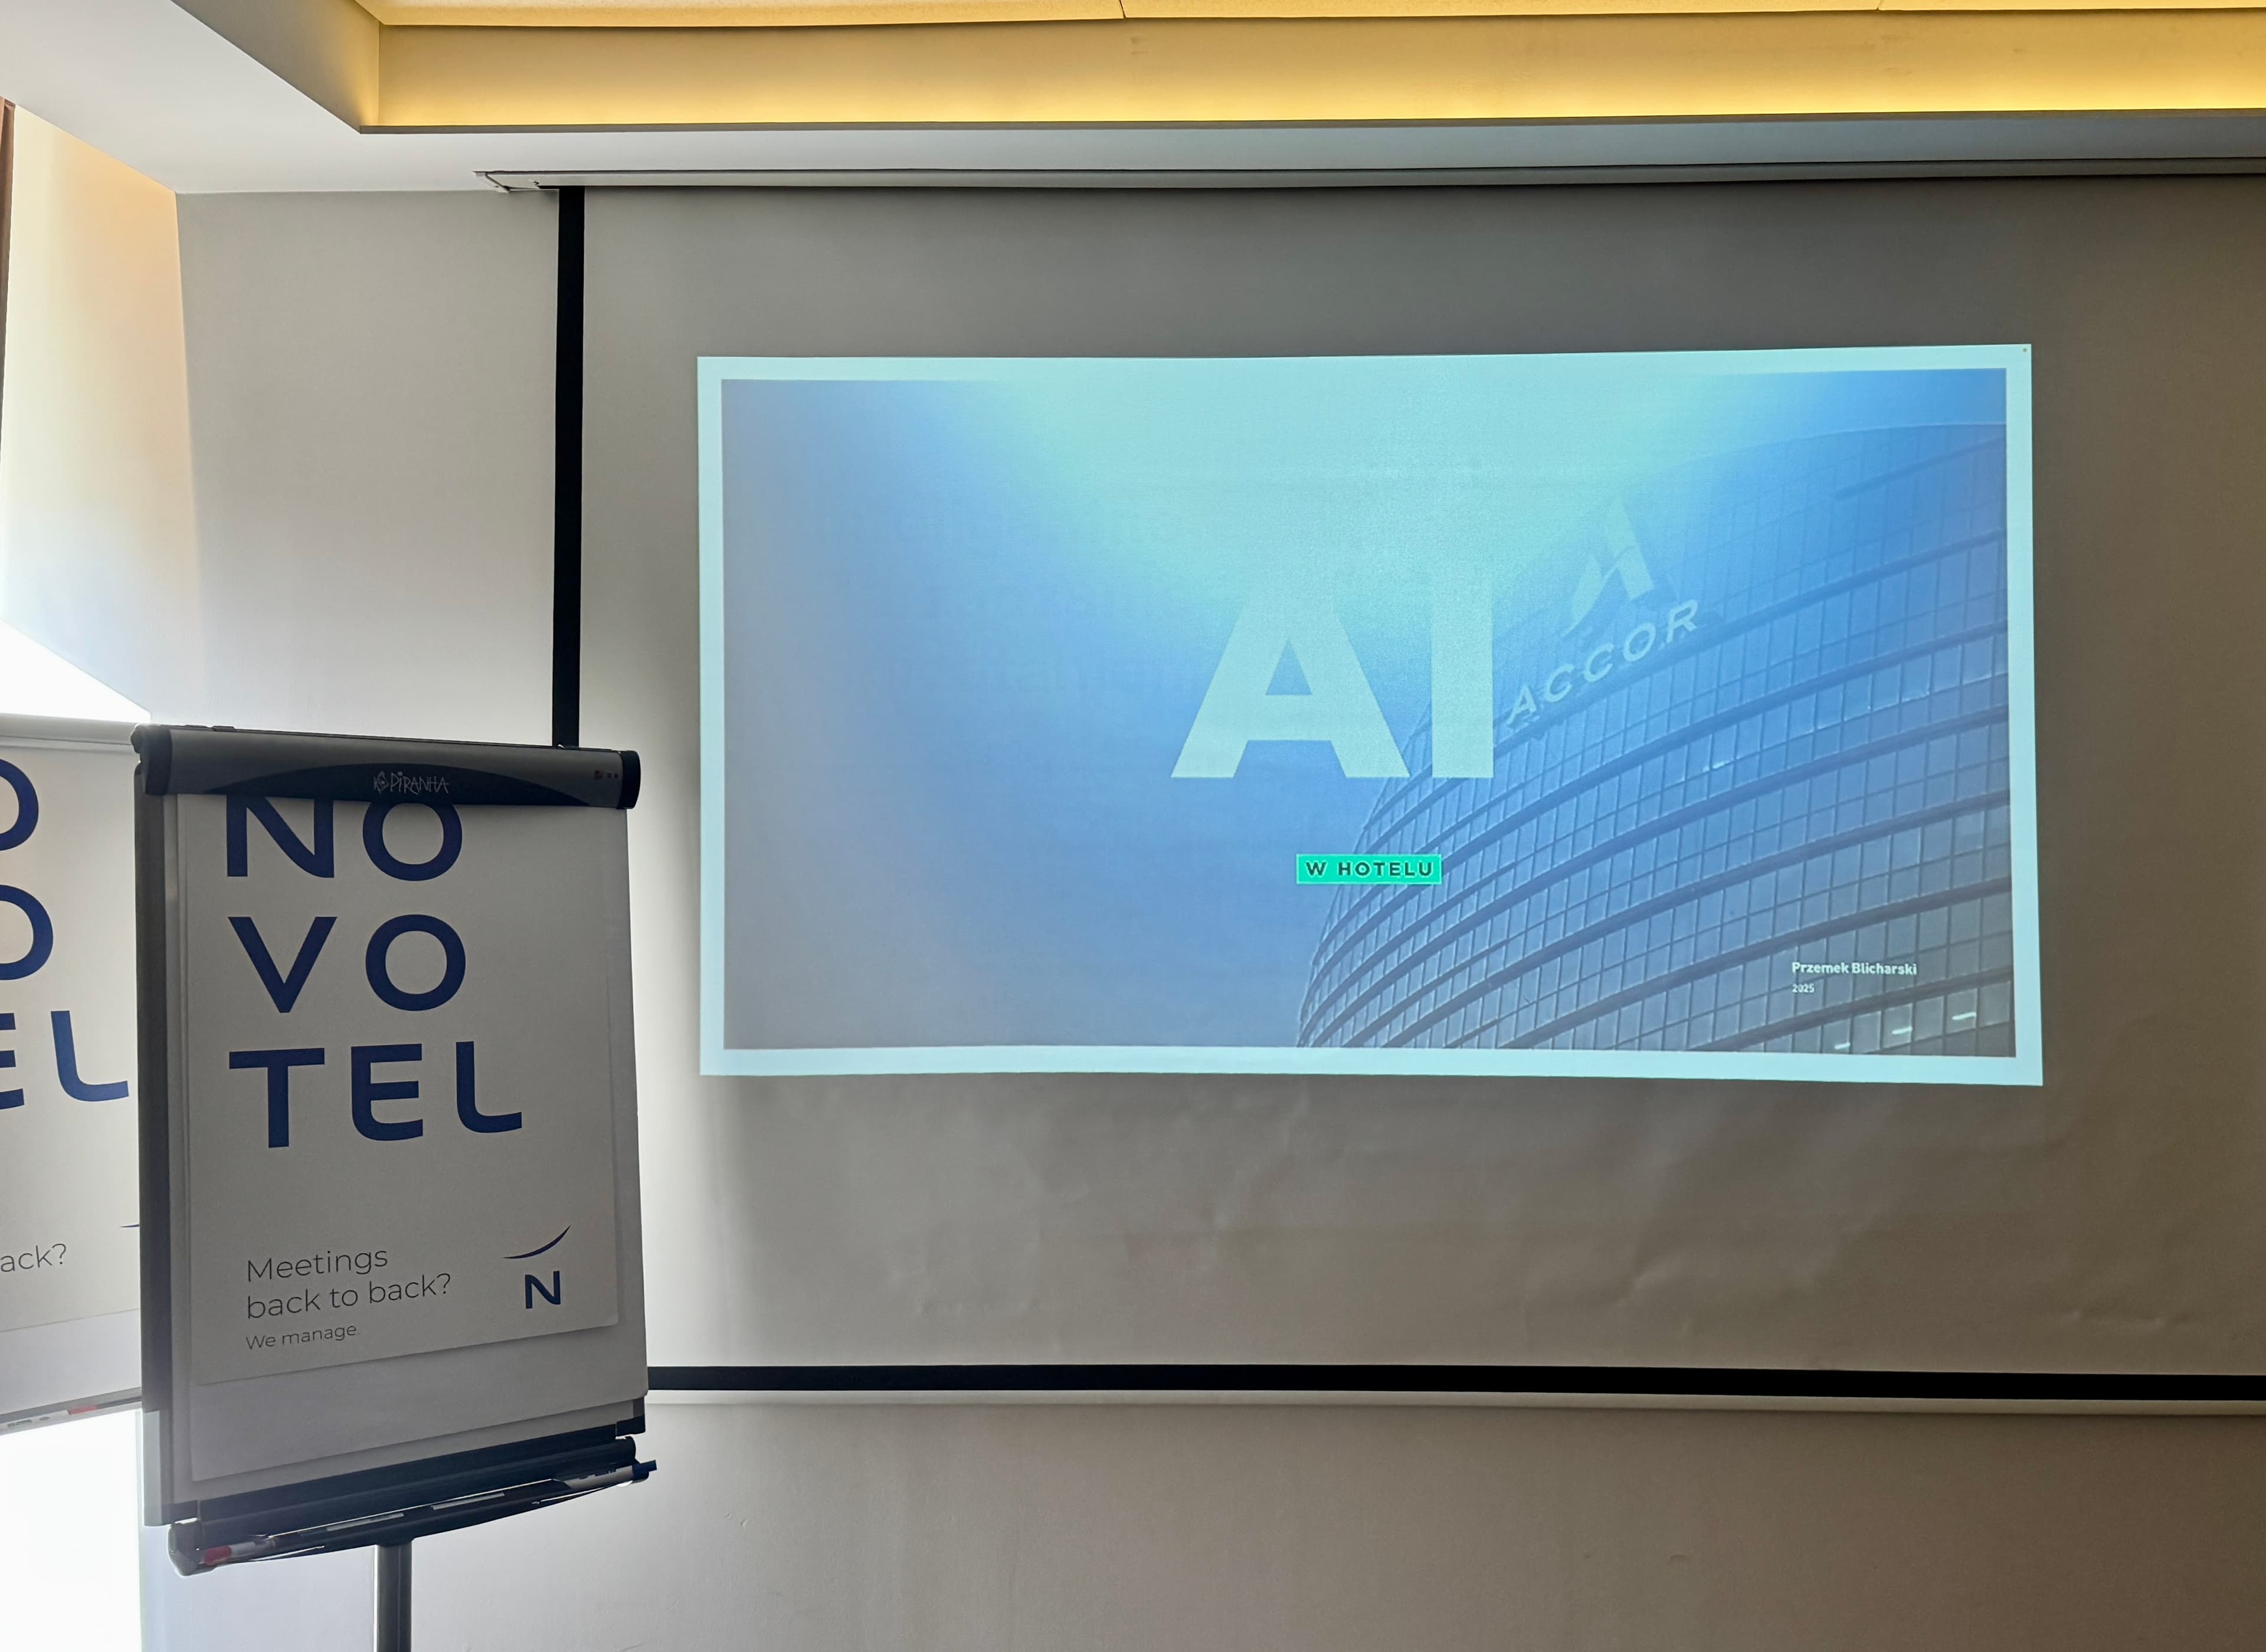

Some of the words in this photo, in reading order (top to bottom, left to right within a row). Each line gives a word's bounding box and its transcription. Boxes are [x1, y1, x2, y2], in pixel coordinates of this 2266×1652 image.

[1171, 573, 1495, 778] AI
[1507, 599, 1698, 729] ACCOR
[227, 794, 462, 881] NO
[1306, 862, 1327, 876] W
[1338, 862, 1432, 876] HOTELU
[228, 914, 466, 1013] VO
[1792, 962, 1849, 974] Przemek
[1852, 962, 1917, 975] Blicharski
[1792, 984, 1815, 993] 2025
[229, 1041, 522, 1148] TEL
[247, 1250, 388, 1282] Meetings
[248, 1288, 321, 1319] back
[329, 1288, 358, 1308] to
[369, 1273, 451, 1303] back?
[525, 1270, 561, 1309] N
[245, 1335, 276, 1349] We
